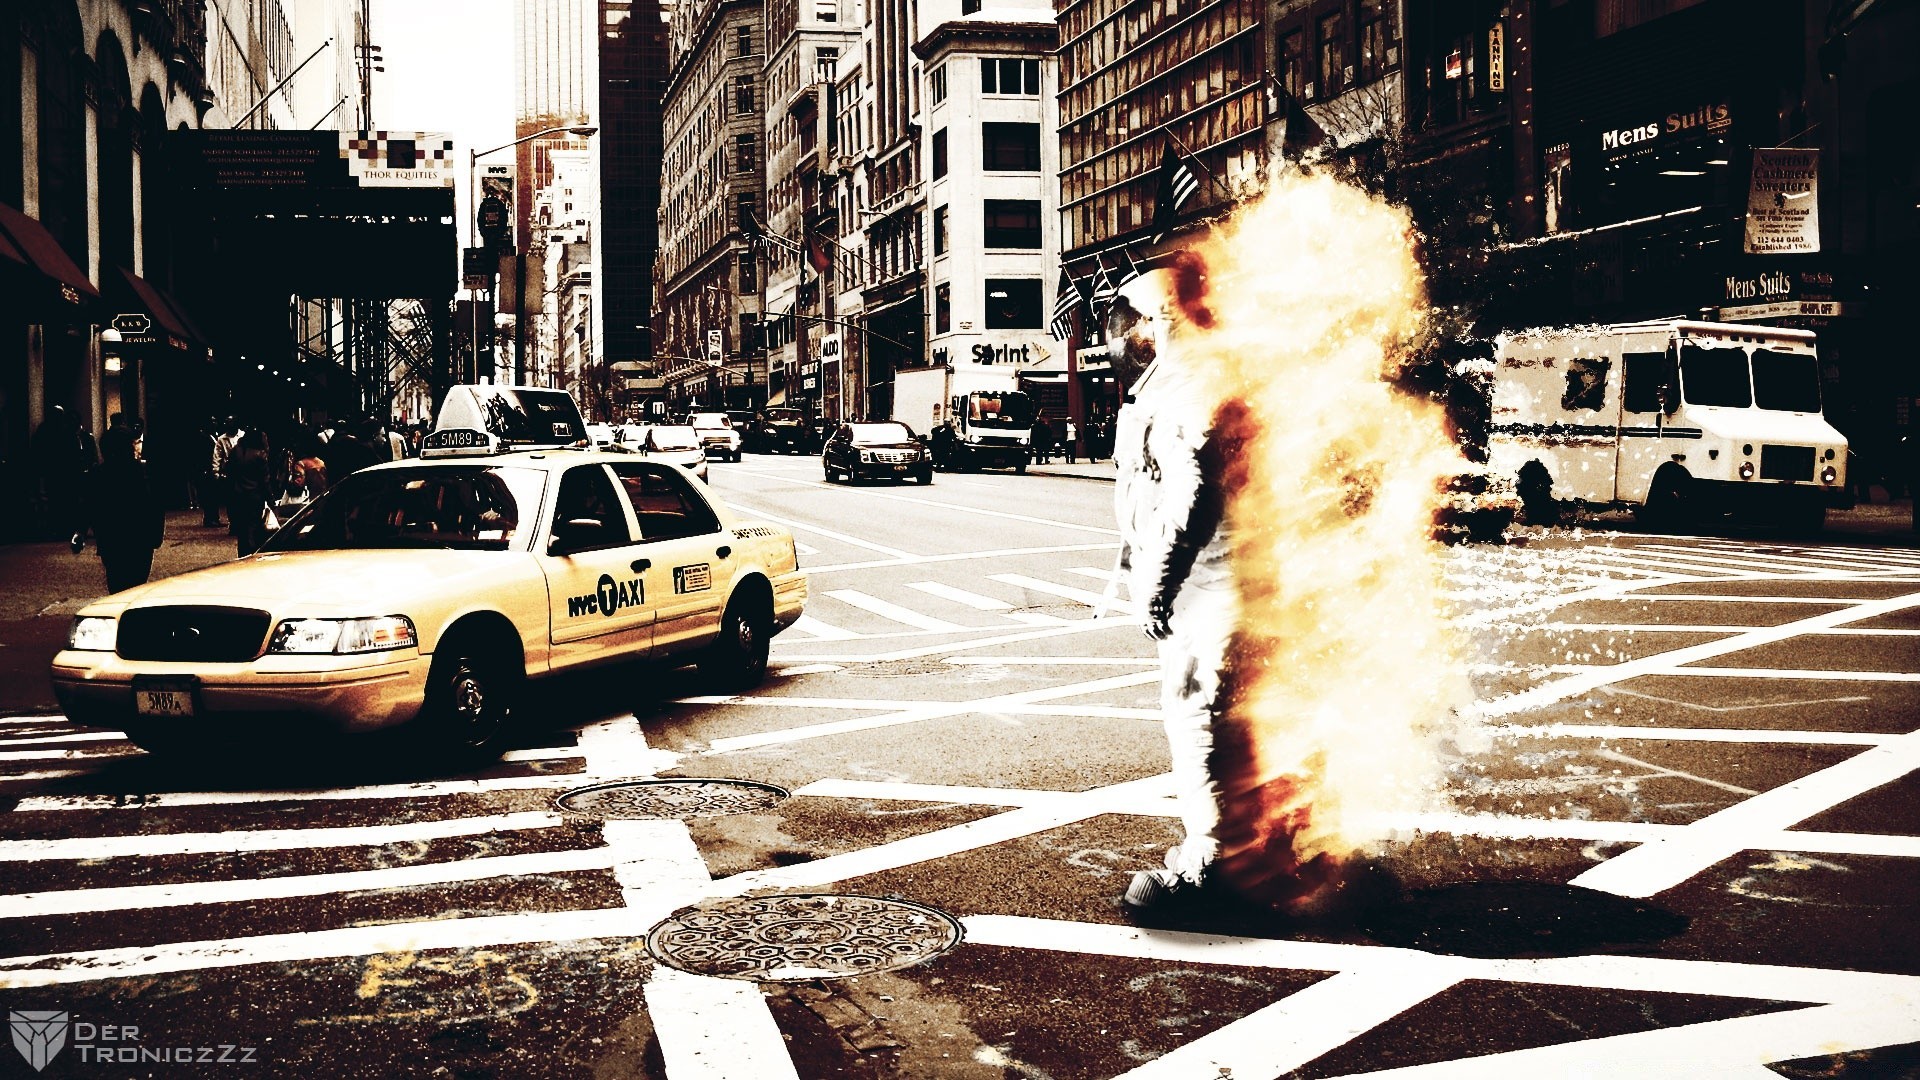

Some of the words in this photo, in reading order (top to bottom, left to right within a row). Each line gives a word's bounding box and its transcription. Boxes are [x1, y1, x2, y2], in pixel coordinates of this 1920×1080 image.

[1492, 29, 1500, 88] TANNING
[1602, 122, 1659, 151] Mens
[1665, 104, 1728, 133] Suits
[1761, 154, 1809, 166] Scottish
[364, 171, 391, 179] THOR
[395, 171, 438, 180] EQUITIES
[488, 166, 507, 174] NYC
[1754, 167, 1814, 179] Cashmere
[1755, 180, 1810, 192] Sweaters
[1778, 208, 1809, 216] Scotland
[1725, 276, 1756, 300] Mens
[1759, 269, 1791, 296] Suits
[1820, 303, 1833, 314] OFF
[823, 340, 838, 357] ALDO
[441, 432, 472, 446] 5M89
[568, 594, 597, 617] NYC
[598, 574, 645, 616] TAXI
